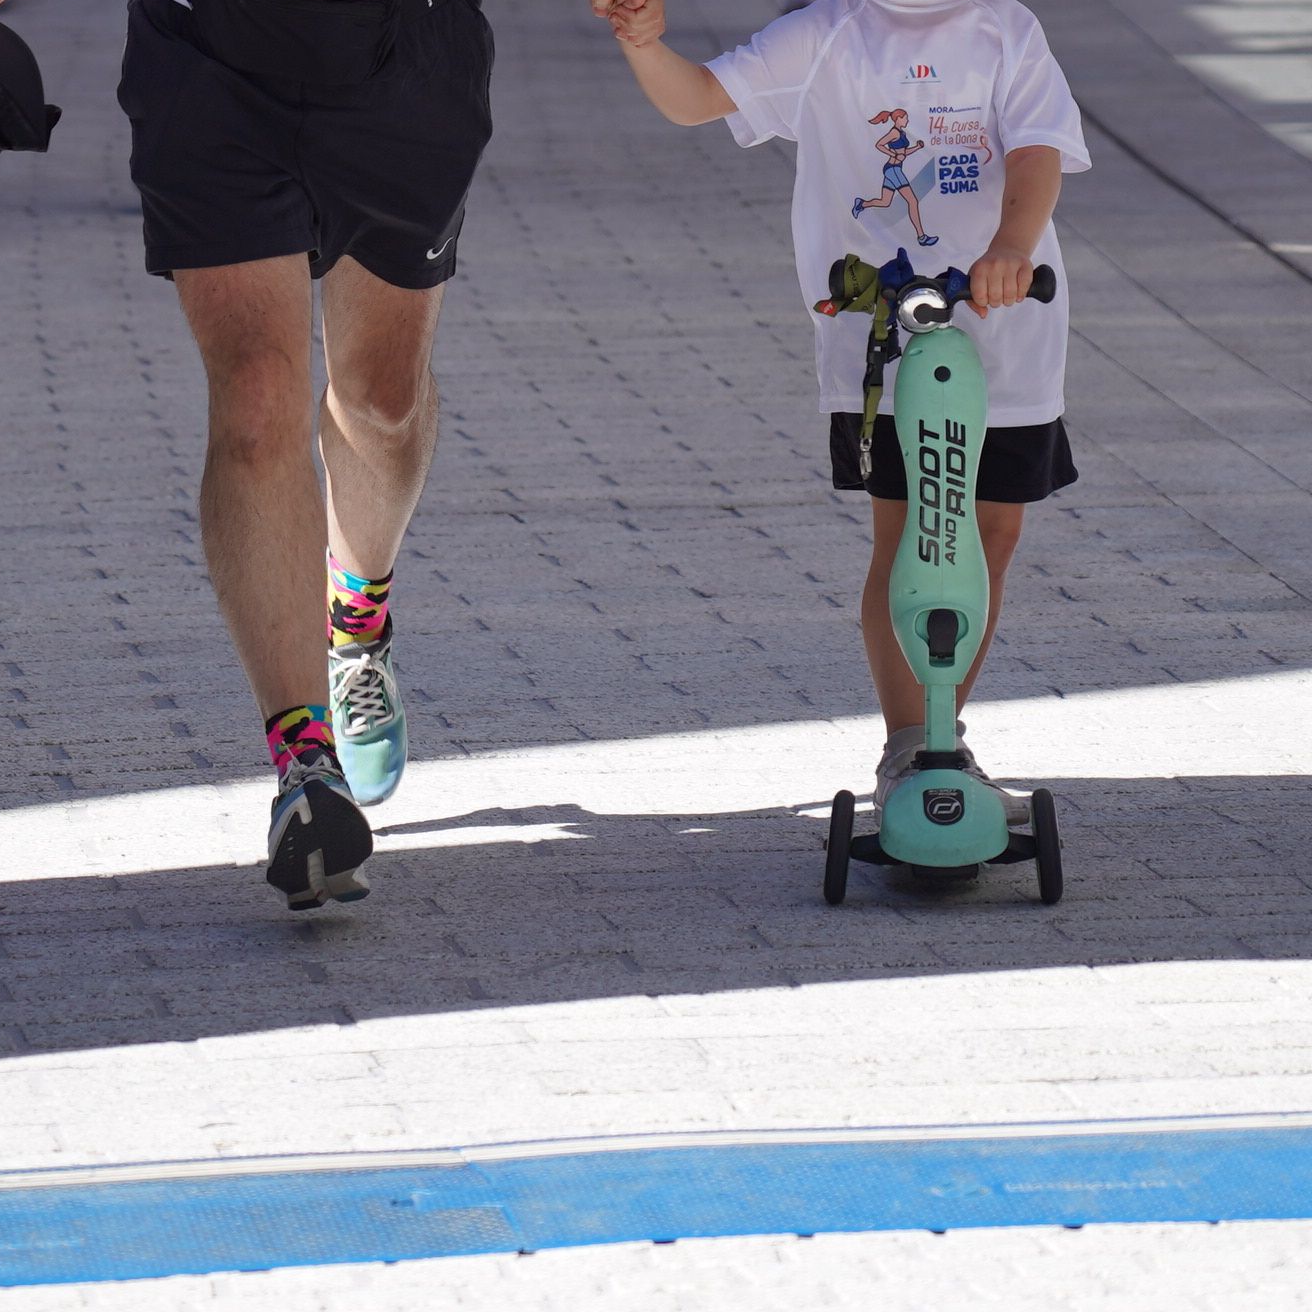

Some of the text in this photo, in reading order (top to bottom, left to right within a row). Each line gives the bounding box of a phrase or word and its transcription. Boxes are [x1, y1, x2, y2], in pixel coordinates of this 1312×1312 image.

[905, 64, 937, 79] ADA
[928, 106, 954, 114] MORA
[951, 120, 980, 133] Cursa
[930, 133, 978, 146] de la Dona
[938, 152, 978, 166] CADA
[939, 165, 980, 180] PAS
[940, 179, 979, 195] SUMA
[918, 419, 941, 567] SCOOT
[944, 418, 966, 566] AND RIDE
